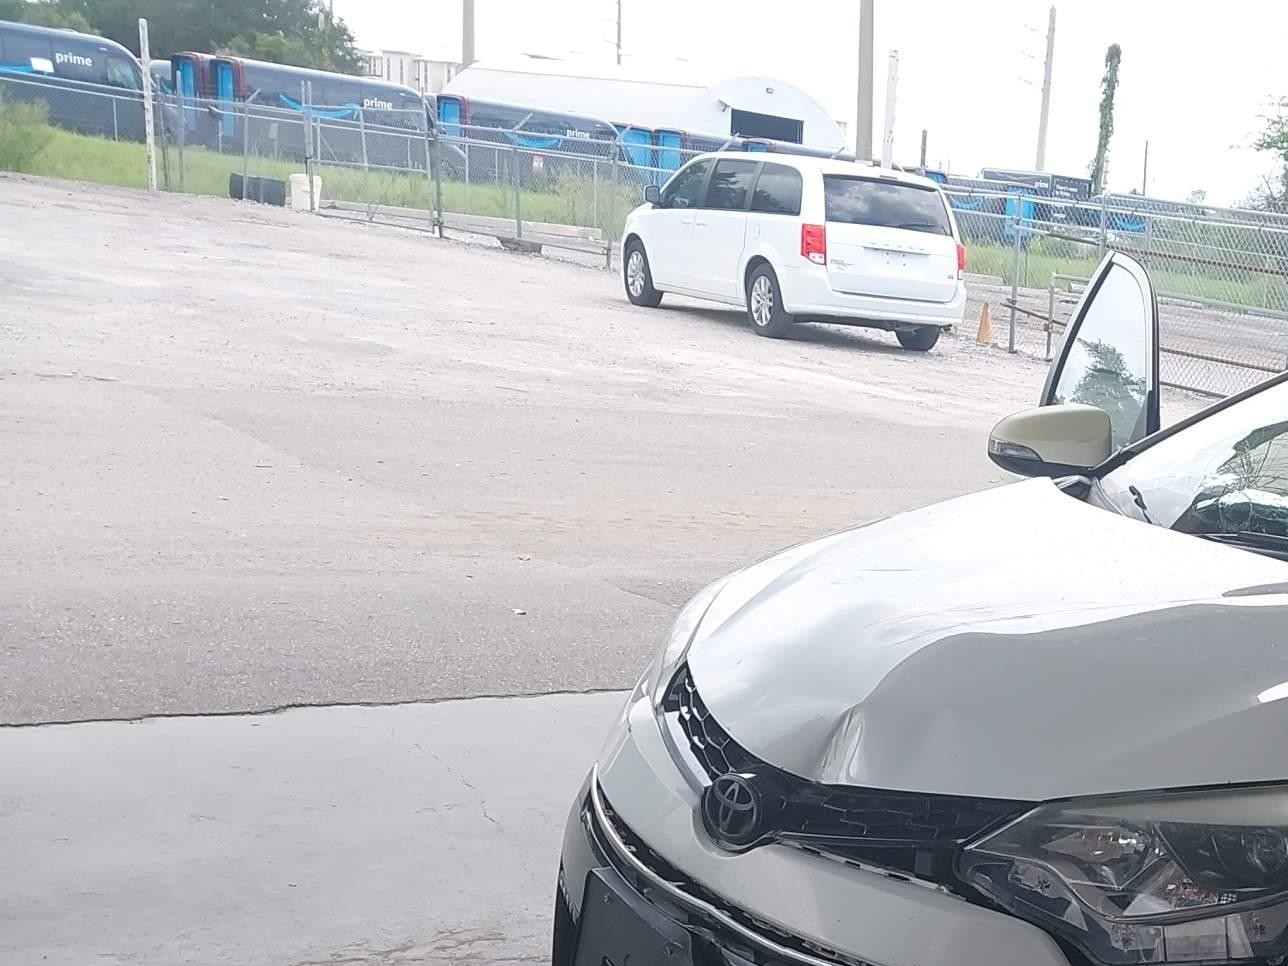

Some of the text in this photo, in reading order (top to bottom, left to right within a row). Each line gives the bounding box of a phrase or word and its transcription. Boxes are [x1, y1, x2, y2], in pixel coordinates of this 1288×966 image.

[55, 51, 92, 67] prime
[363, 97, 392, 110] prime
[566, 129, 590, 139] prime
